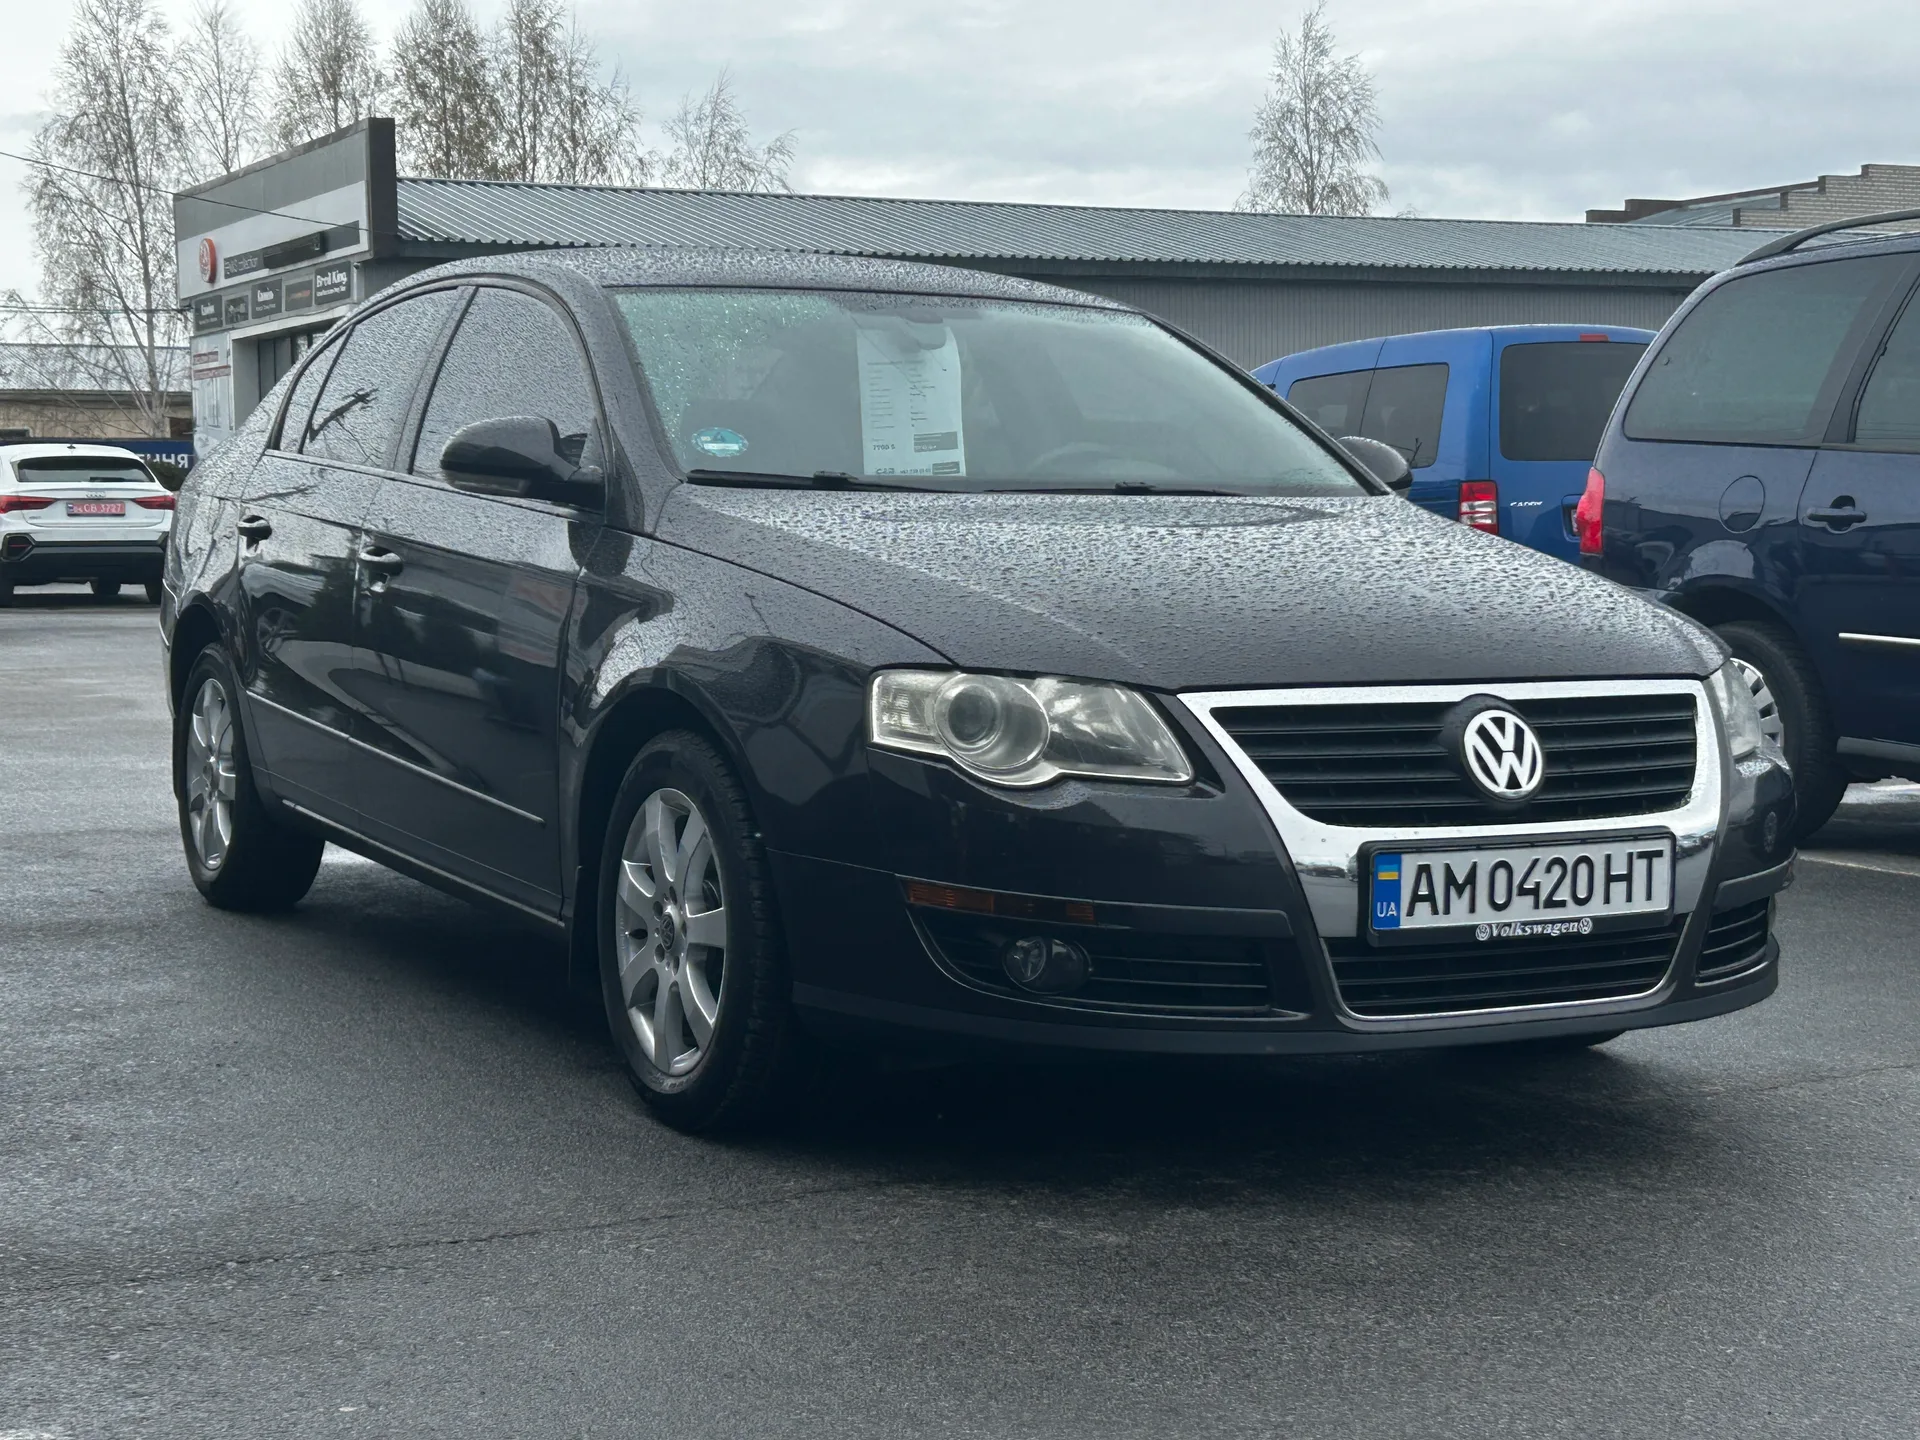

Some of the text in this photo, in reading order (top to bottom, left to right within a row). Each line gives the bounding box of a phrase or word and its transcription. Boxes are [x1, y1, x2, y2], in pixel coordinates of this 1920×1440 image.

[1466, 711, 1540, 794] VW
[1376, 901, 1398, 918] UA
[1491, 921, 1578, 937] Volkswagen
